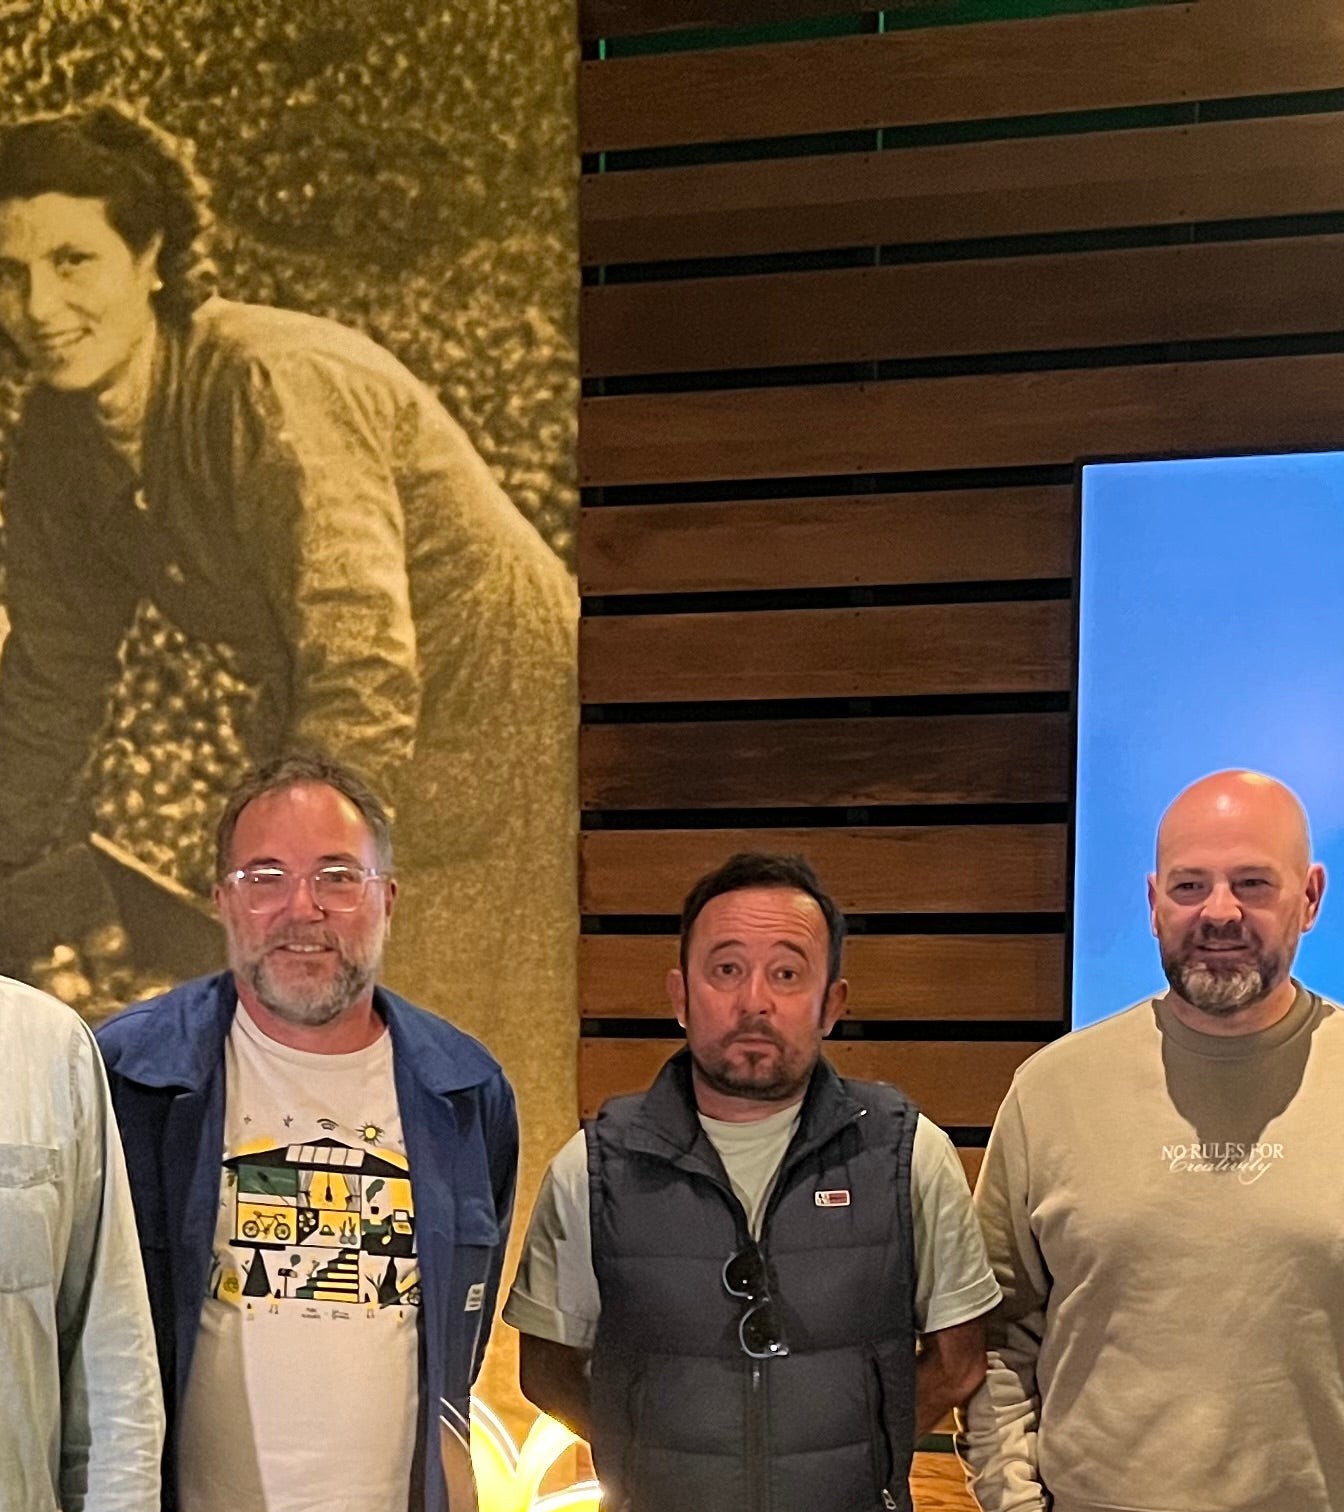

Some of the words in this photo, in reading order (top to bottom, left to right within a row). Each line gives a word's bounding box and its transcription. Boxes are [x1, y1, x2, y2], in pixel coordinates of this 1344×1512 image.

[1161, 1145, 1187, 1161] NO
[1190, 1142, 1245, 1160] RULES
[1249, 1142, 1284, 1161] FOR
